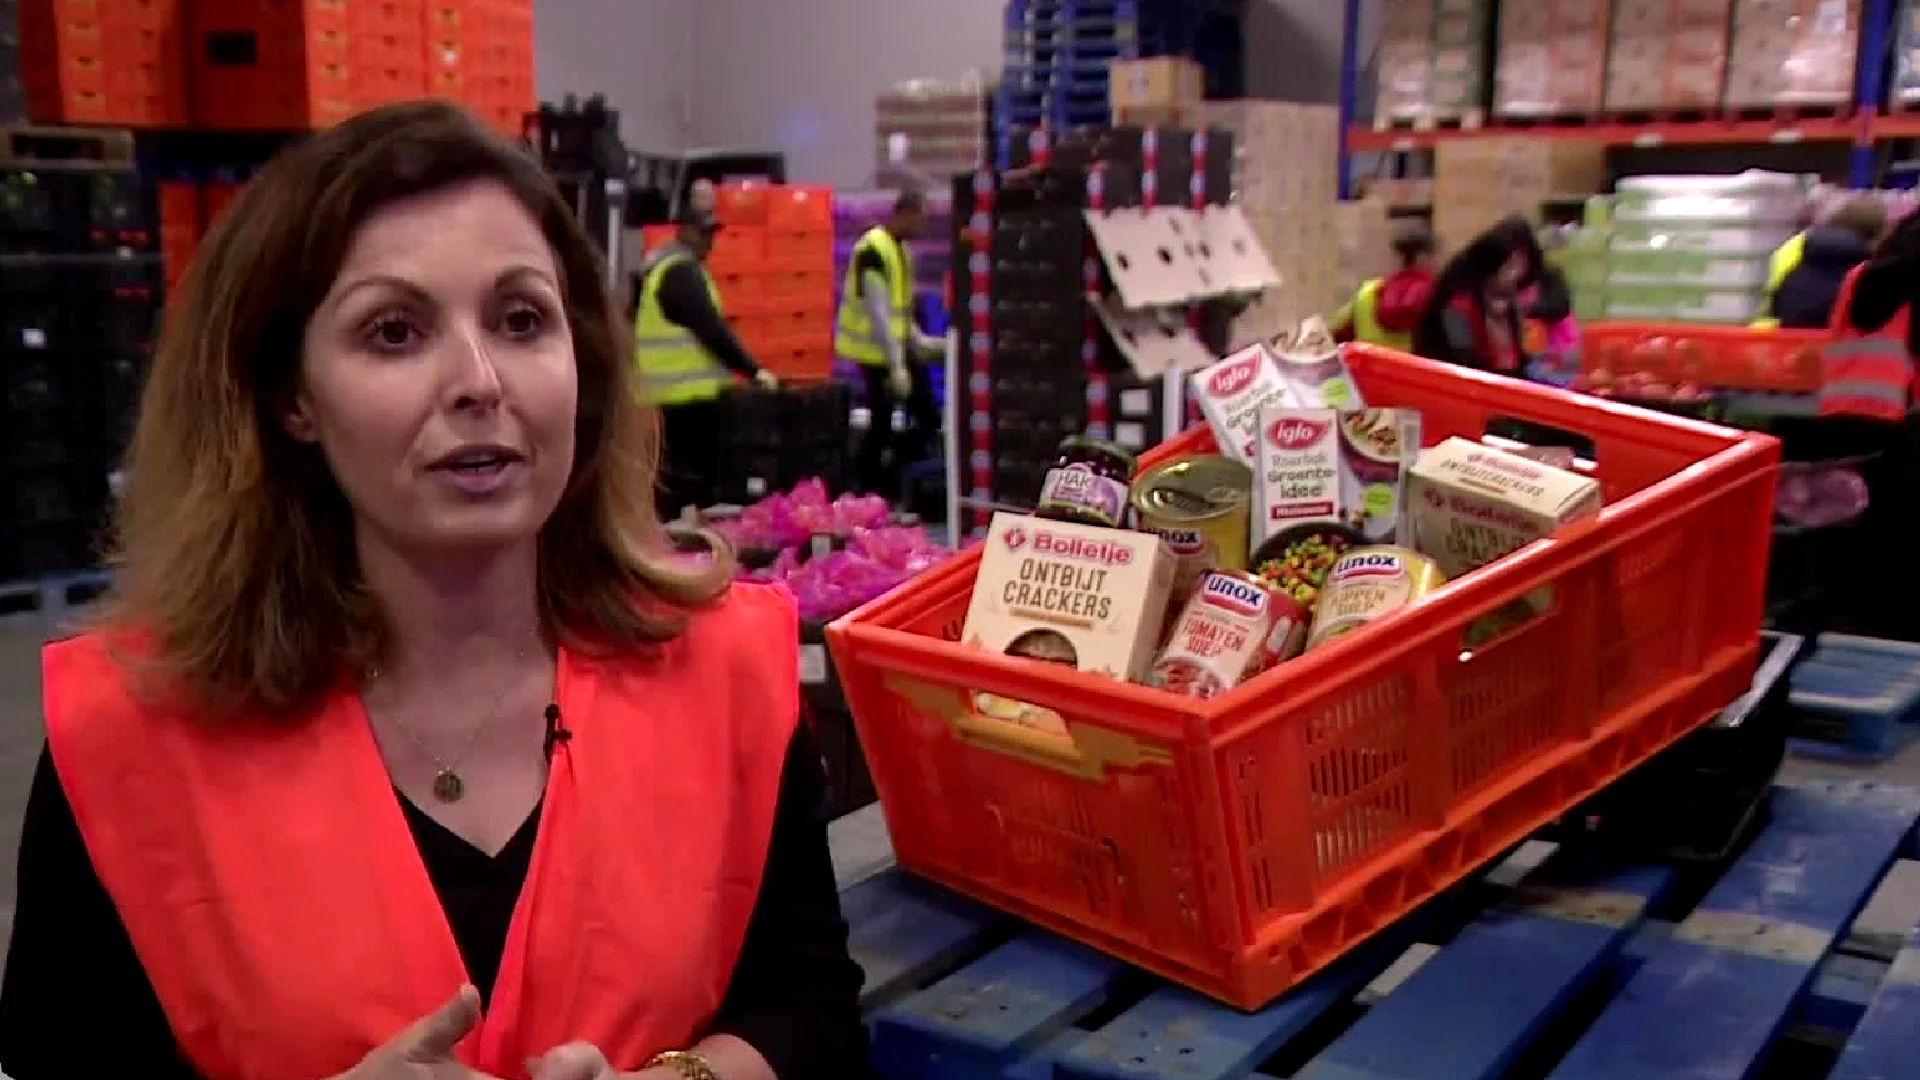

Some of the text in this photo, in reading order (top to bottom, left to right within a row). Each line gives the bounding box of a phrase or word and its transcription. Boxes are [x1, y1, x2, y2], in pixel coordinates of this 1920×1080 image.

[1033, 530, 1131, 565] Bolletje
[1019, 557, 1108, 592] ONTBIJT
[1003, 580, 1112, 619] CRACKERS
